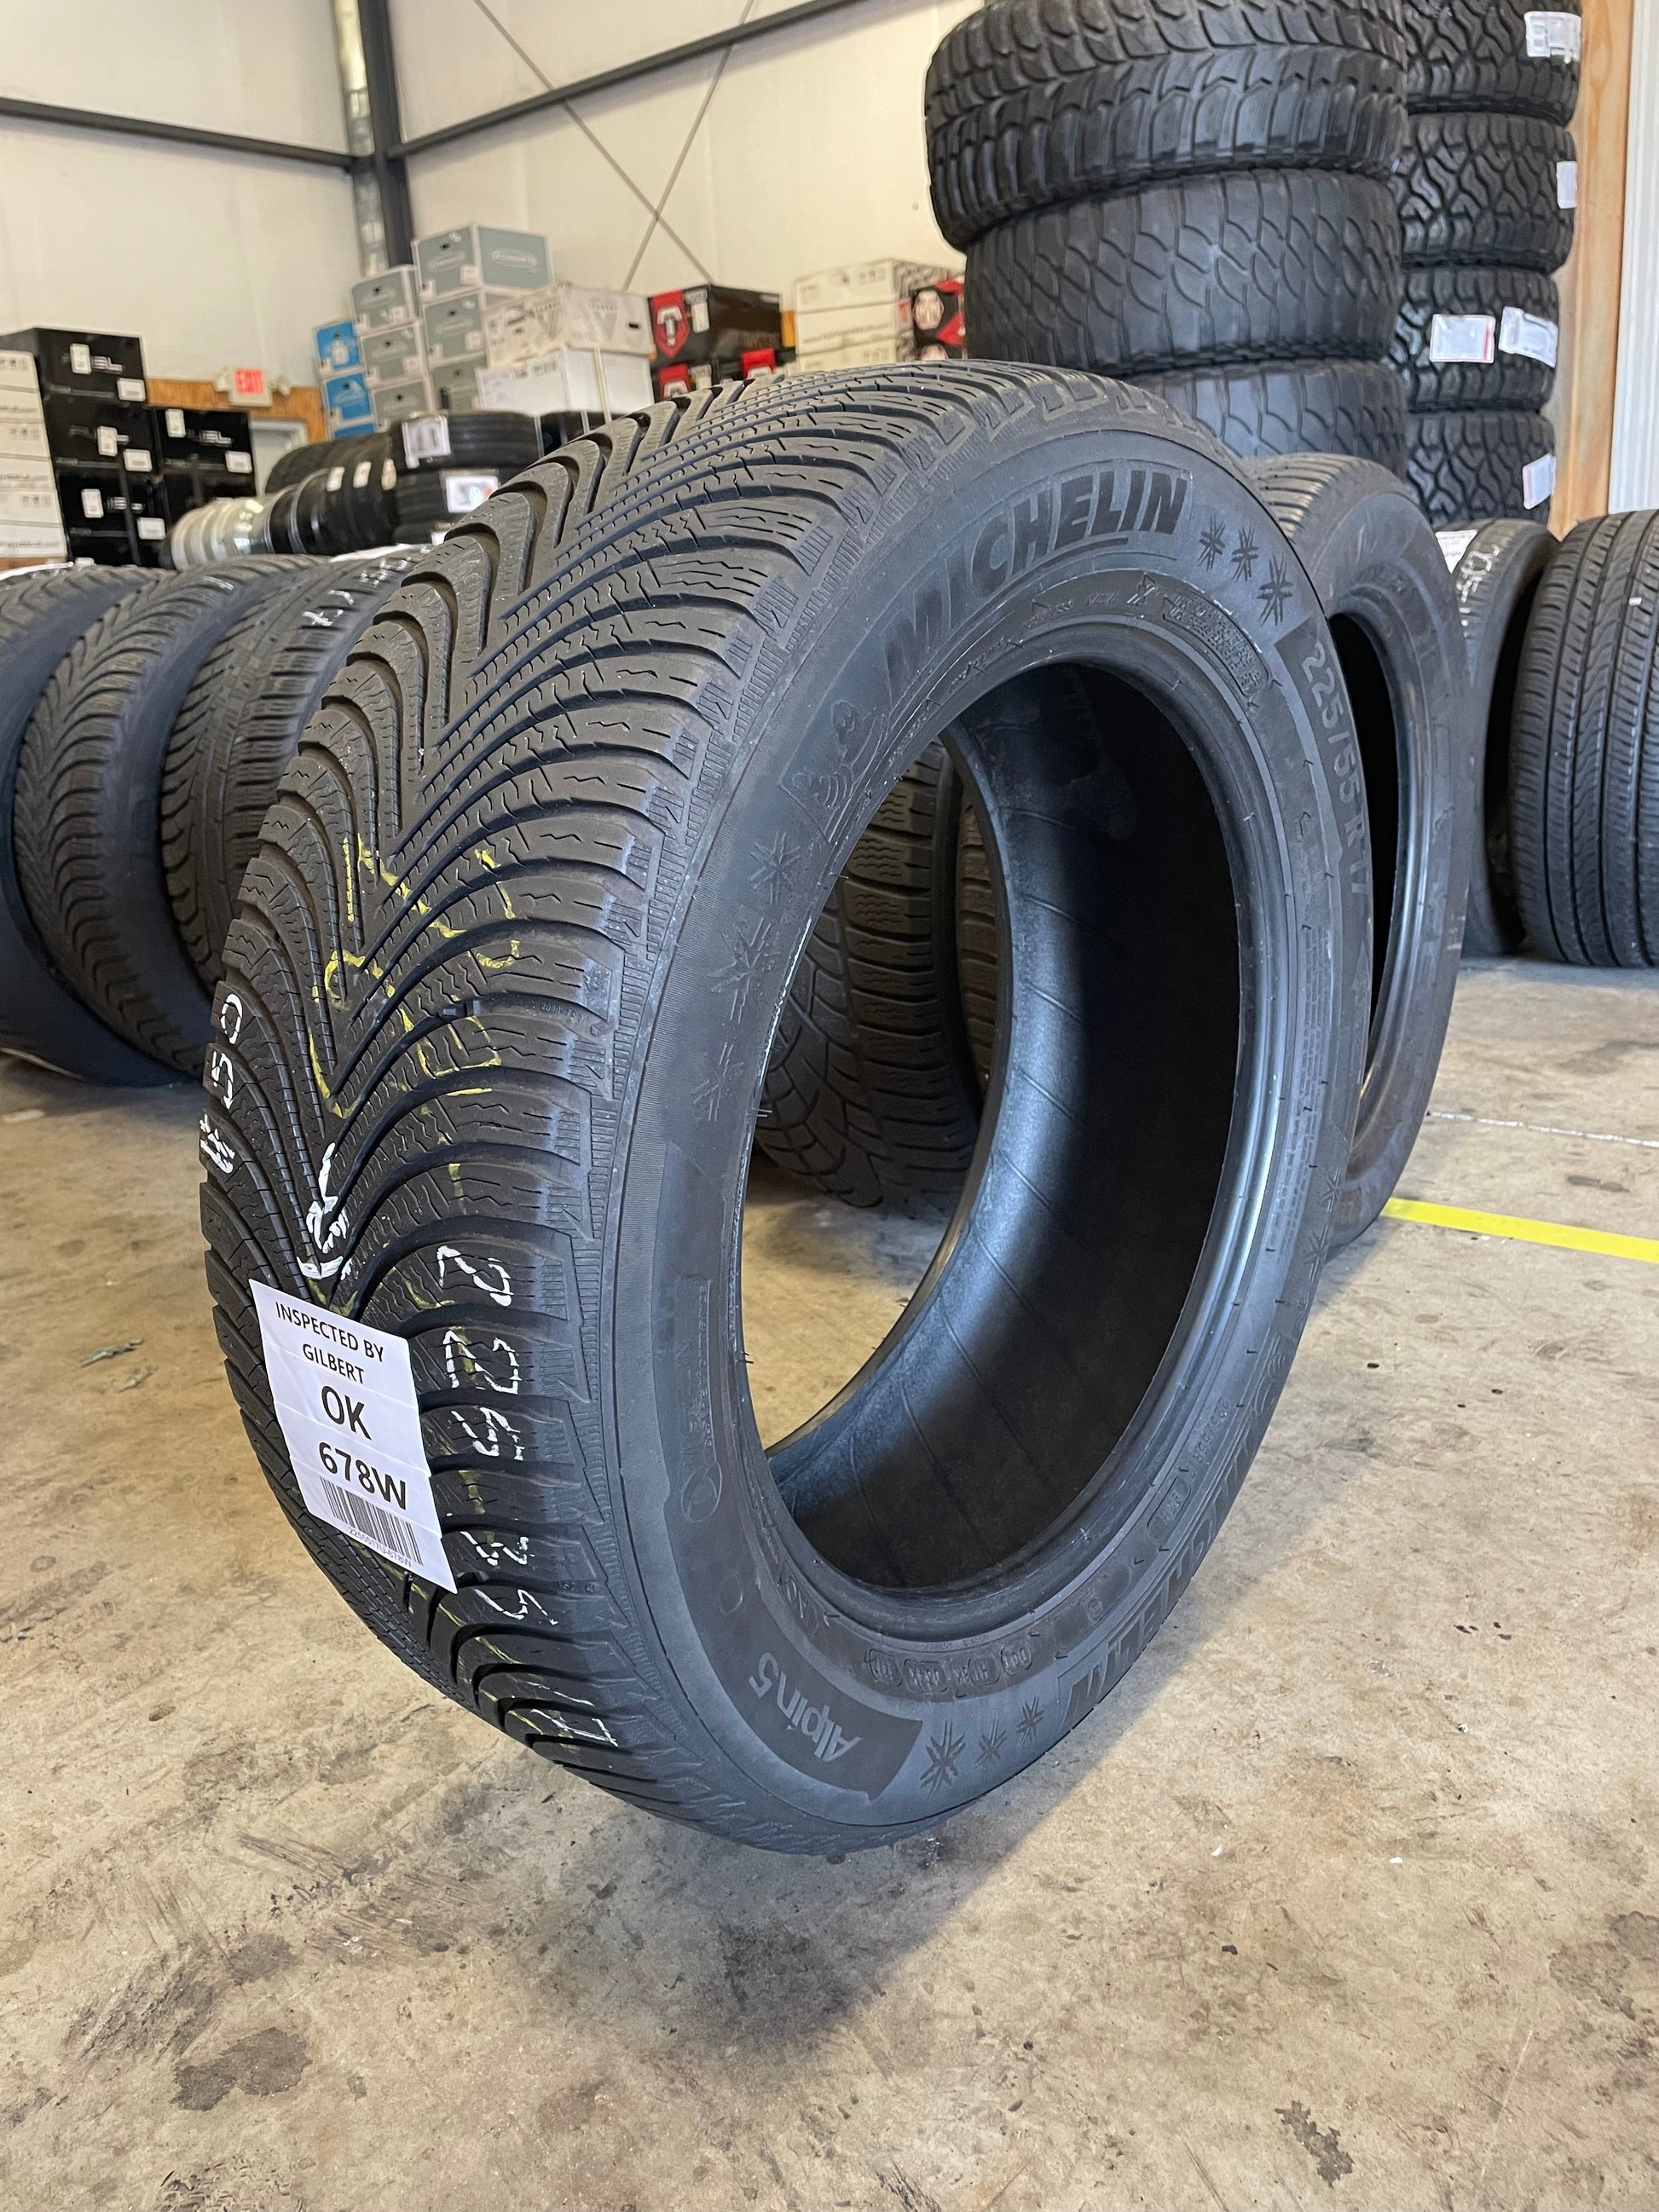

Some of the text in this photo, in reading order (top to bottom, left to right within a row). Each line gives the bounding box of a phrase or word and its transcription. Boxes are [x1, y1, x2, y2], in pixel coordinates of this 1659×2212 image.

[884, 470, 1189, 701] MICHELIN
[275, 1302, 384, 1363] INSPECTED BY
[302, 1343, 364, 1384] GILBERT
[321, 1385, 373, 1441] OK
[319, 1441, 407, 1510] 678W
